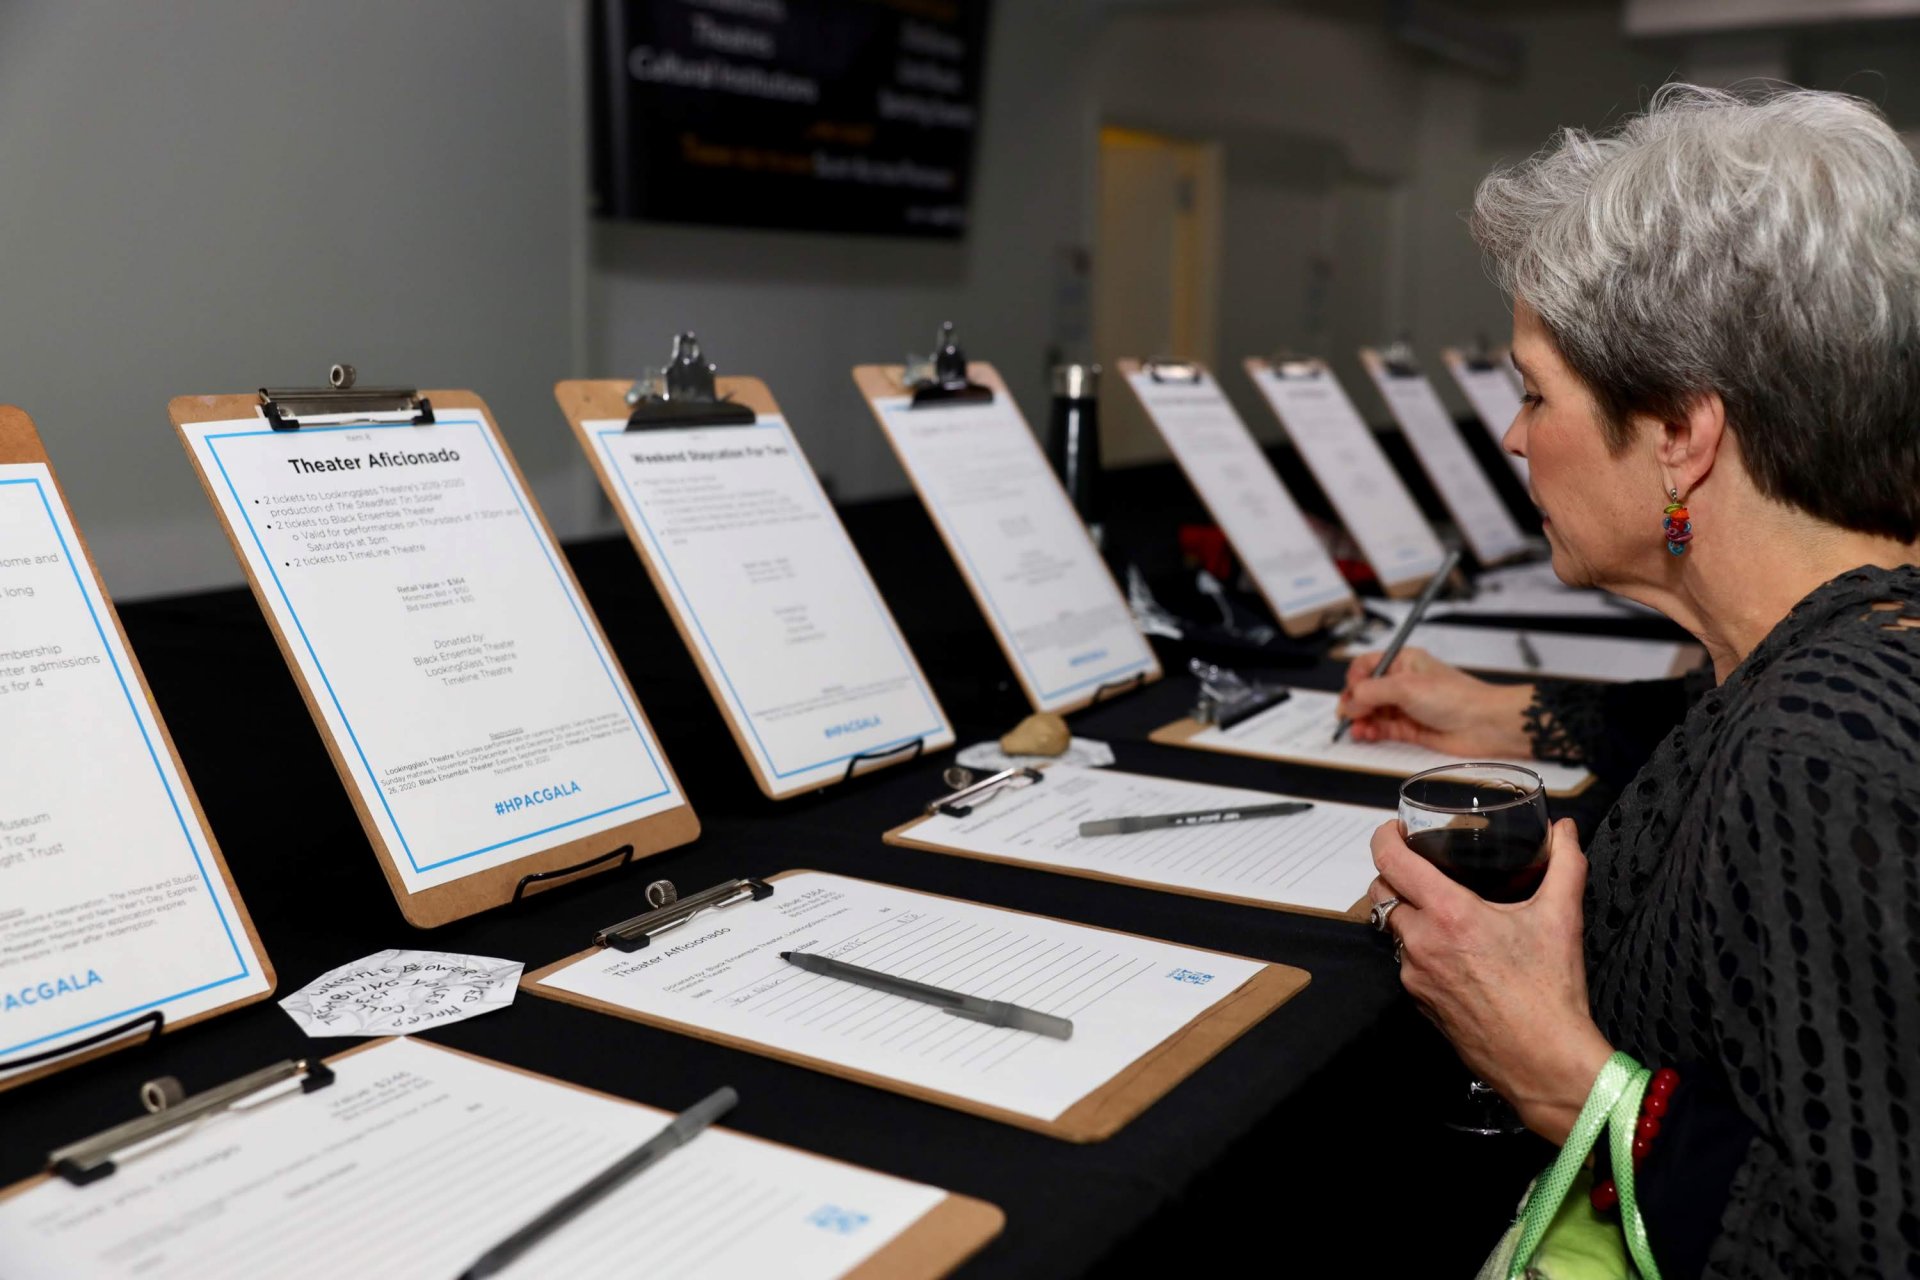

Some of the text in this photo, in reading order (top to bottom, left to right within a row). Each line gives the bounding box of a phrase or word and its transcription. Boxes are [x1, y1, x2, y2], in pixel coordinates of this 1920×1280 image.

[288, 448, 460, 474] Theater Aficionado
[263, 496, 271, 505] 2
[272, 494, 306, 504] tickets
[306, 493, 318, 501] to
[318, 488, 379, 500] Lookingglass
[270, 506, 323, 518] production
[324, 502, 334, 512] of
[336, 502, 354, 510] The
[355, 498, 396, 509] Steadfast
[275, 520, 284, 530] 2
[284, 519, 317, 529] tickets
[330, 514, 356, 524] Black
[357, 510, 401, 521] Ensemble
[300, 529, 326, 540] Valid
[326, 528, 340, 537] for
[343, 522, 405, 537] performances
[406, 520, 419, 528] on
[306, 536, 388, 552] Saturdays at 3pm
[34, 552, 60, 566] and
[293, 544, 426, 568] 2 tickets to TimeLine Theatre
[4, 586, 35, 598] long
[434, 635, 472, 649] Donated
[31, 655, 101, 674] admissions
[413, 654, 439, 666] Black
[439, 646, 482, 661] Ensemble
[424, 659, 484, 678] LookingGlass
[12, 677, 44, 692] for 4
[384, 760, 429, 776] Lookingglass
[418, 776, 438, 786] Black
[438, 768, 469, 781] Ensemble
[380, 776, 406, 787] Sunday
[494, 781, 581, 816] #HPACGALA
[172, 872, 199, 887] Studio
[166, 883, 198, 898] Expires
[612, 928, 731, 977] Theater Afficionado
